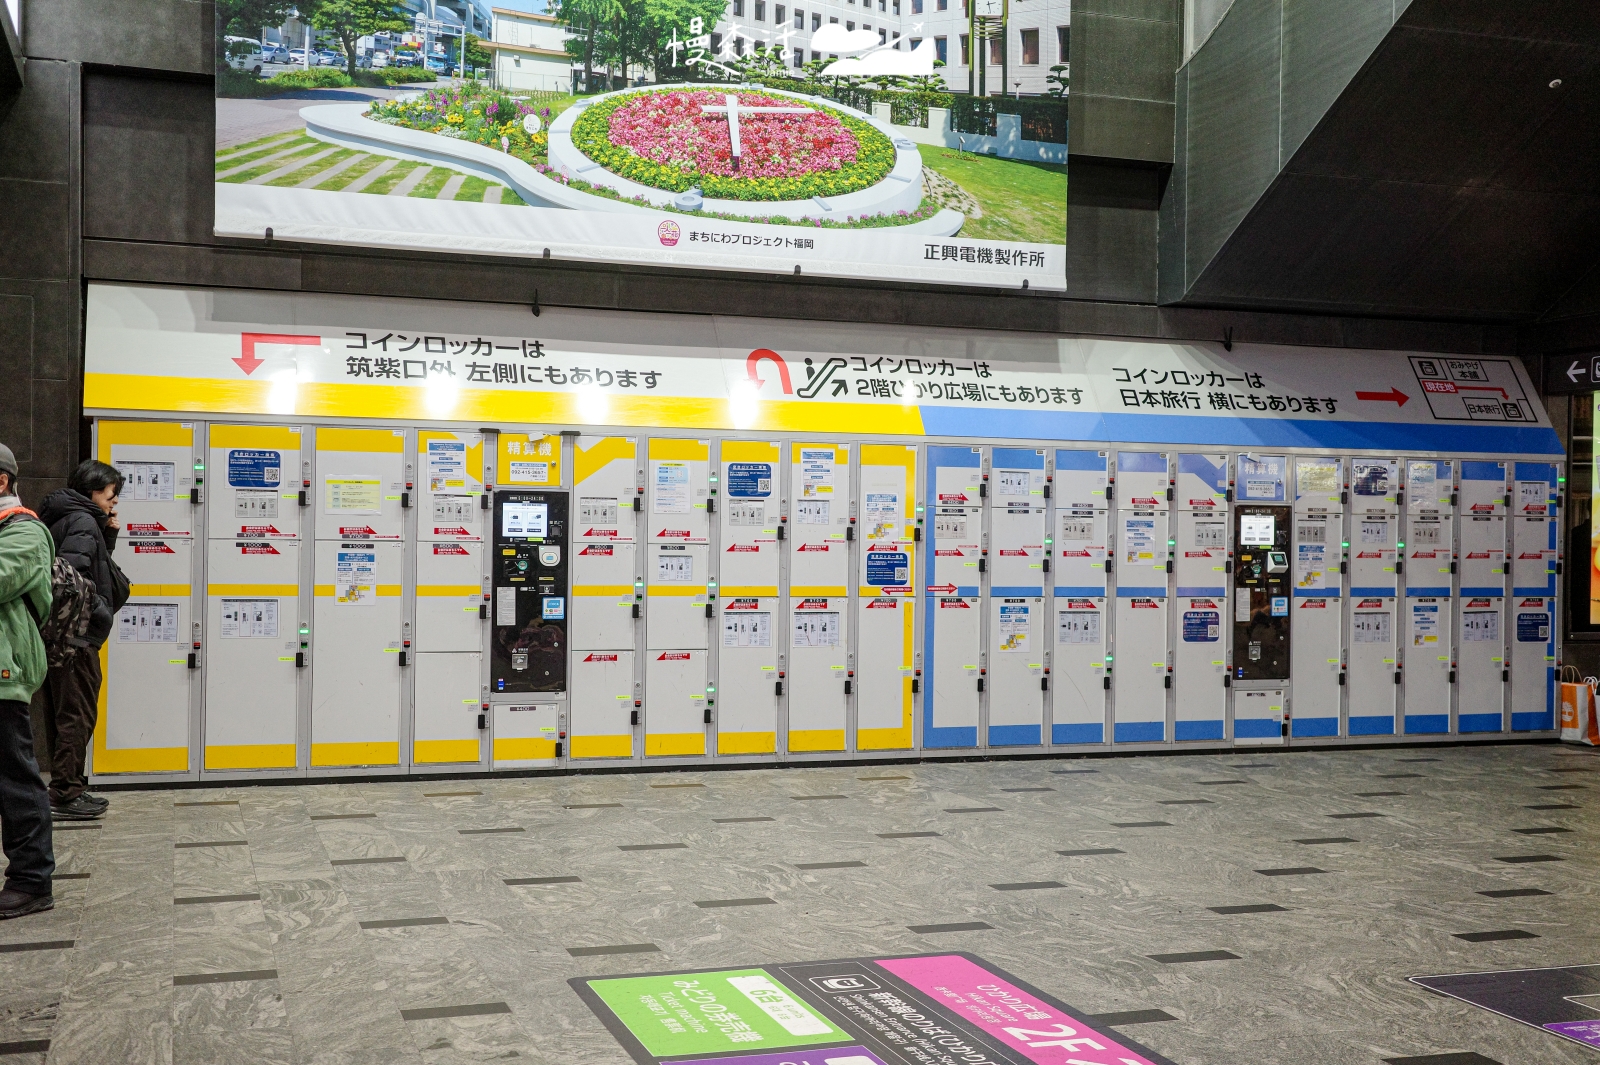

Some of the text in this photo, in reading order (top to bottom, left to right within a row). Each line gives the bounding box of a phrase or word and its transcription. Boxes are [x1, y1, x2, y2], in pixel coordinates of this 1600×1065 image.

[689, 231, 814, 250] まちにわプロジェクト福岡
[924, 243, 1046, 268] 正興電機製作所
[345, 331, 546, 359] コインロッカーは
[465, 361, 663, 389] 左側にもあります
[850, 356, 993, 379] コインロッカーは
[1112, 366, 1266, 389] コインロッカーは
[1424, 381, 1456, 393] 現在地
[1120, 388, 1339, 415] 日本旅行 横にもあります
[1467, 403, 1502, 415] 日本旅行
[507, 440, 552, 457] 精算機
[1244, 462, 1279, 476] 精算機
[749, 989, 784, 1003] 6台
[976, 985, 1053, 1020] ひかり広場
[658, 991, 708, 1033] Ticket machine
[672, 979, 765, 1042] みどりの券売機
[1003, 1022, 1107, 1054] 2F
